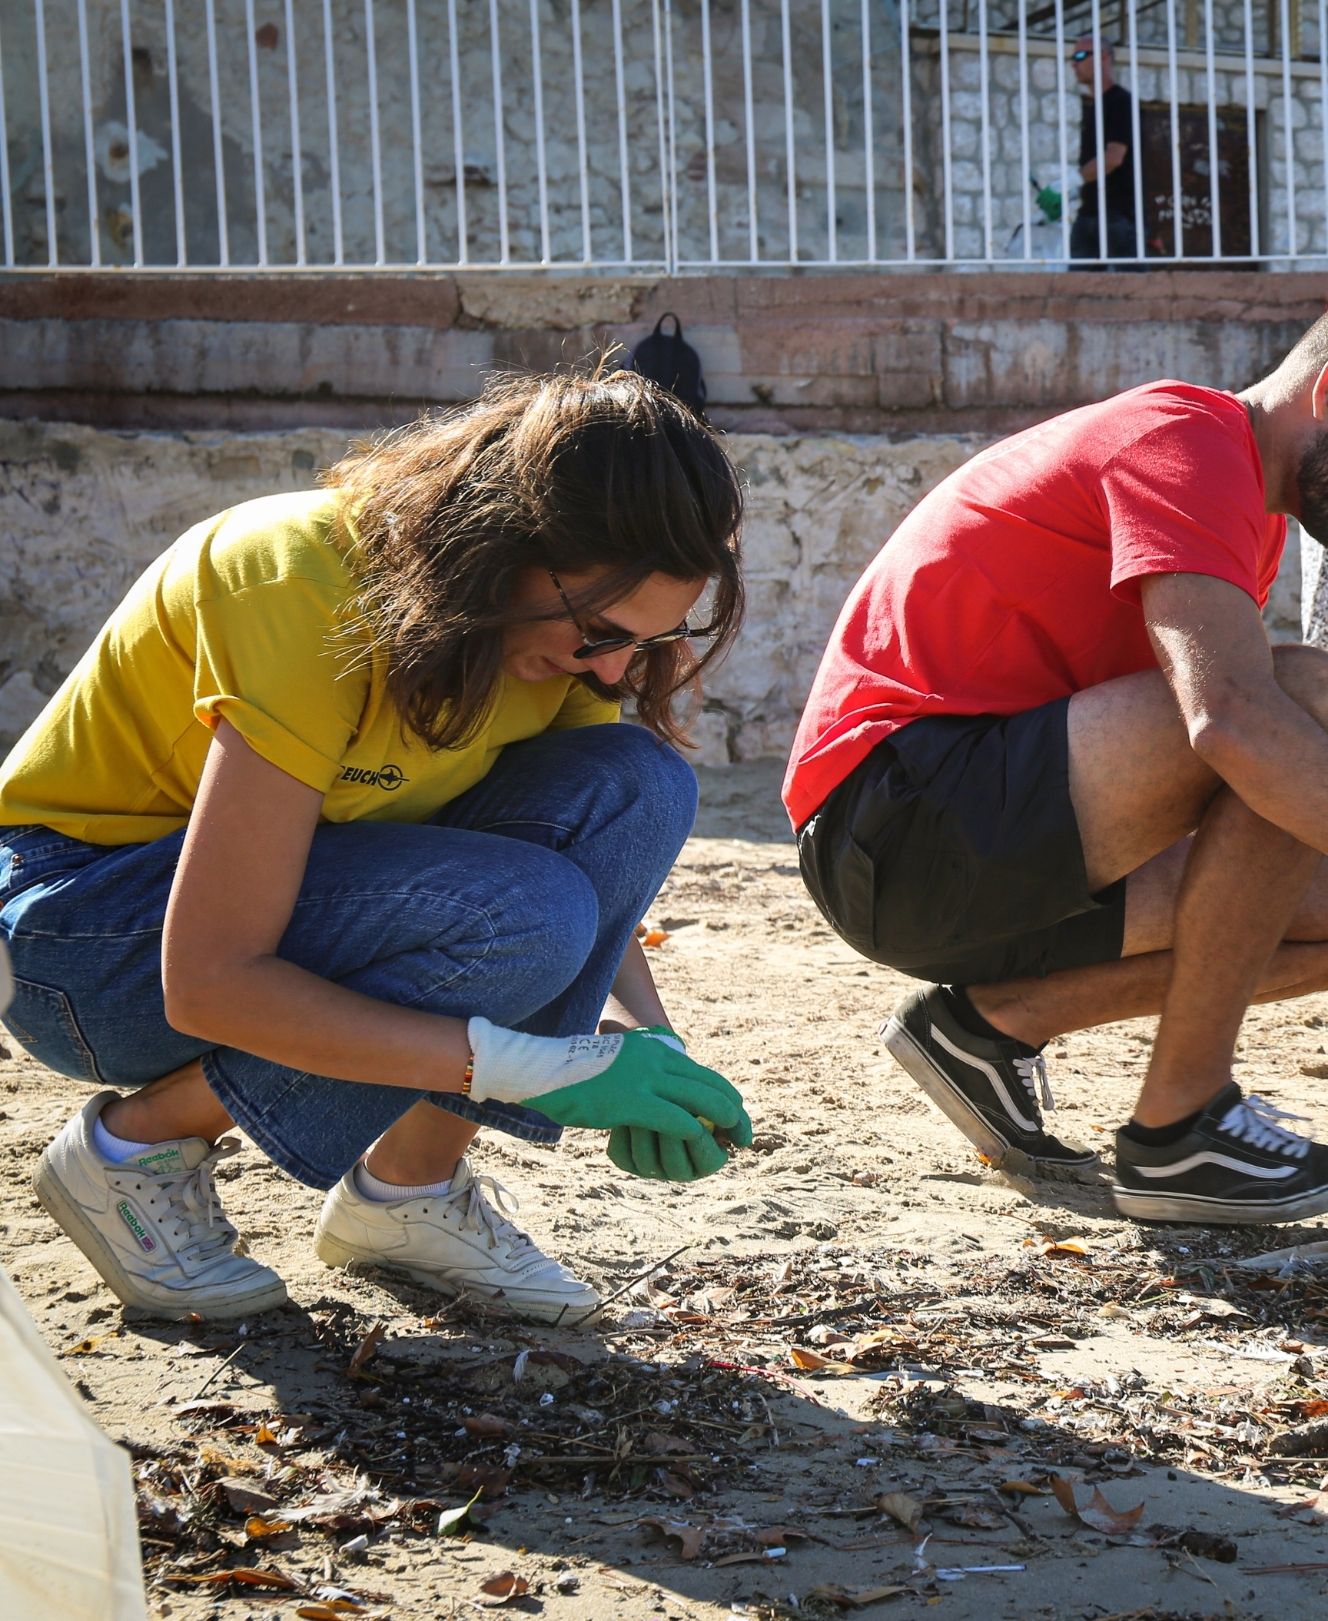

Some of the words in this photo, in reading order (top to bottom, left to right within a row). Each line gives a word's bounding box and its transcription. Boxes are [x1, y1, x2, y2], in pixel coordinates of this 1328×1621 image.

[339, 765, 380, 786] EUCH
[578, 1038, 591, 1051] CE
[138, 1149, 179, 1167] Reebok
[119, 1200, 146, 1239] Reebok
